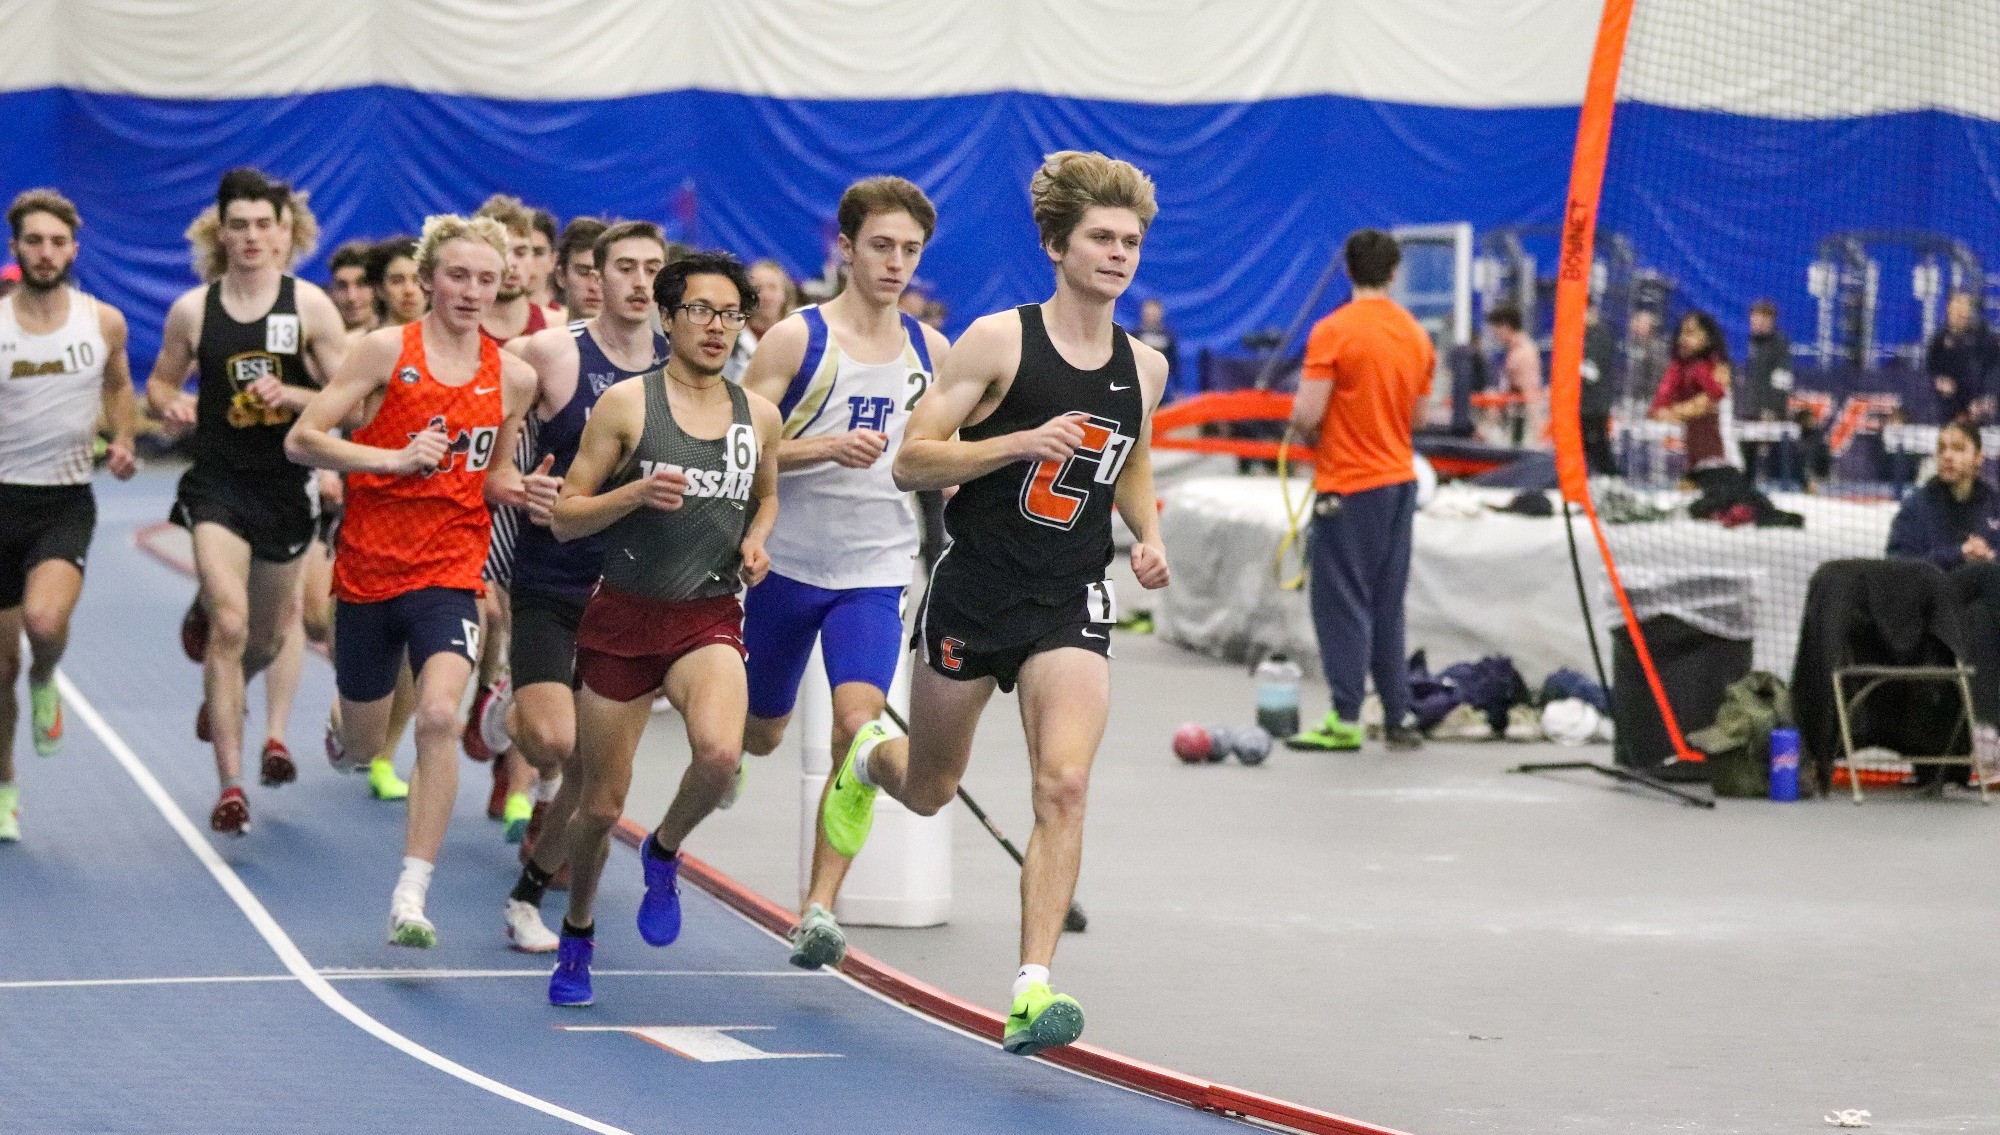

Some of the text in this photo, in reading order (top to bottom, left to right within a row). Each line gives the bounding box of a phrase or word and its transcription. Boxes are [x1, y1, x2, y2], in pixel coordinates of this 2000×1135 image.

[271, 324, 294, 348] 13
[67, 342, 94, 374] 10
[904, 372, 927, 412] 2
[848, 396, 894, 453] H
[473, 430, 493, 467] 9
[734, 426, 751, 470] 6
[1104, 439, 1127, 481] 1
[640, 460, 753, 501] VSSAR
[1092, 582, 1111, 620] 1
